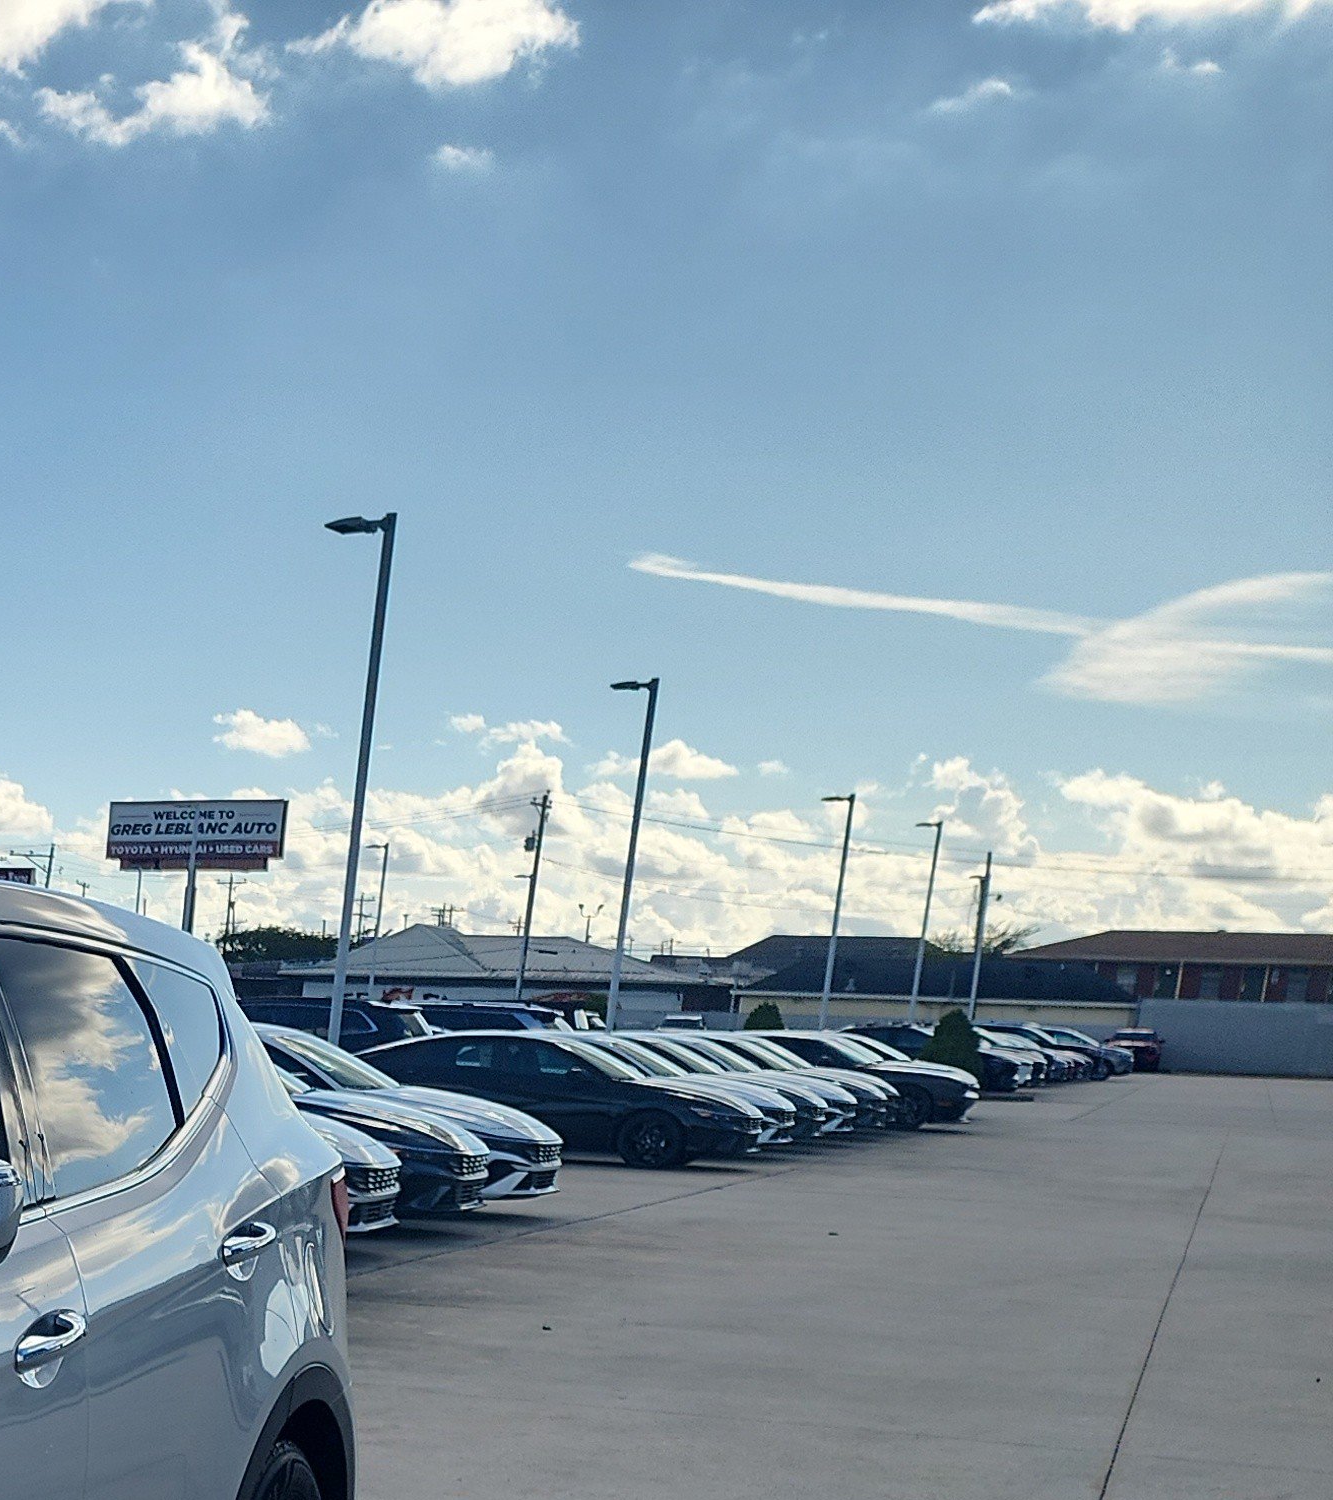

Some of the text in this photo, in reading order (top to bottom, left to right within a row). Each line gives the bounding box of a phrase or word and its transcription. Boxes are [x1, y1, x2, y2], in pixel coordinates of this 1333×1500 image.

[153, 810, 235, 820] WELCOME TO
[111, 822, 277, 836] GREG LEBLANC AUTO
[111, 844, 273, 855] TOYOTA HYUNAI USED CARS
